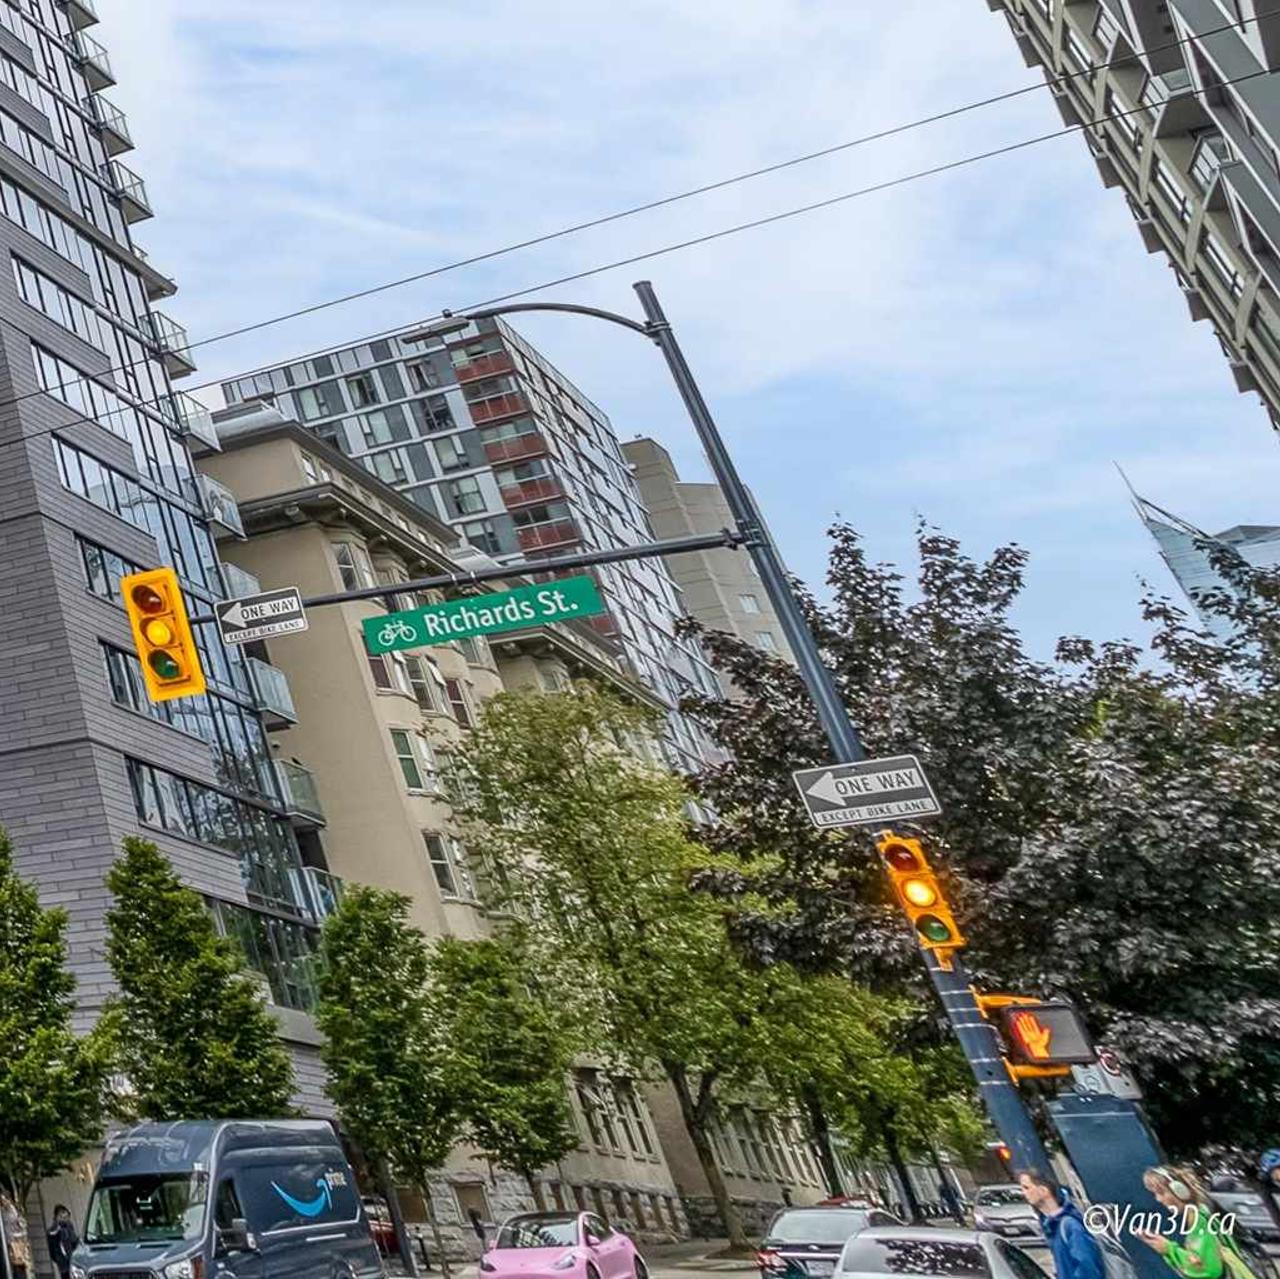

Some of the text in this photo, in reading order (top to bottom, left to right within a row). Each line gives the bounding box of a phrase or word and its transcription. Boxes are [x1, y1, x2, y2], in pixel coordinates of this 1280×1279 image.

[240, 598, 295, 620] ONE WAY
[423, 589, 580, 637] Richards St.
[834, 770, 916, 795] ONE WAY
[821, 800, 928, 823] EXCEPT BIKE LANE
